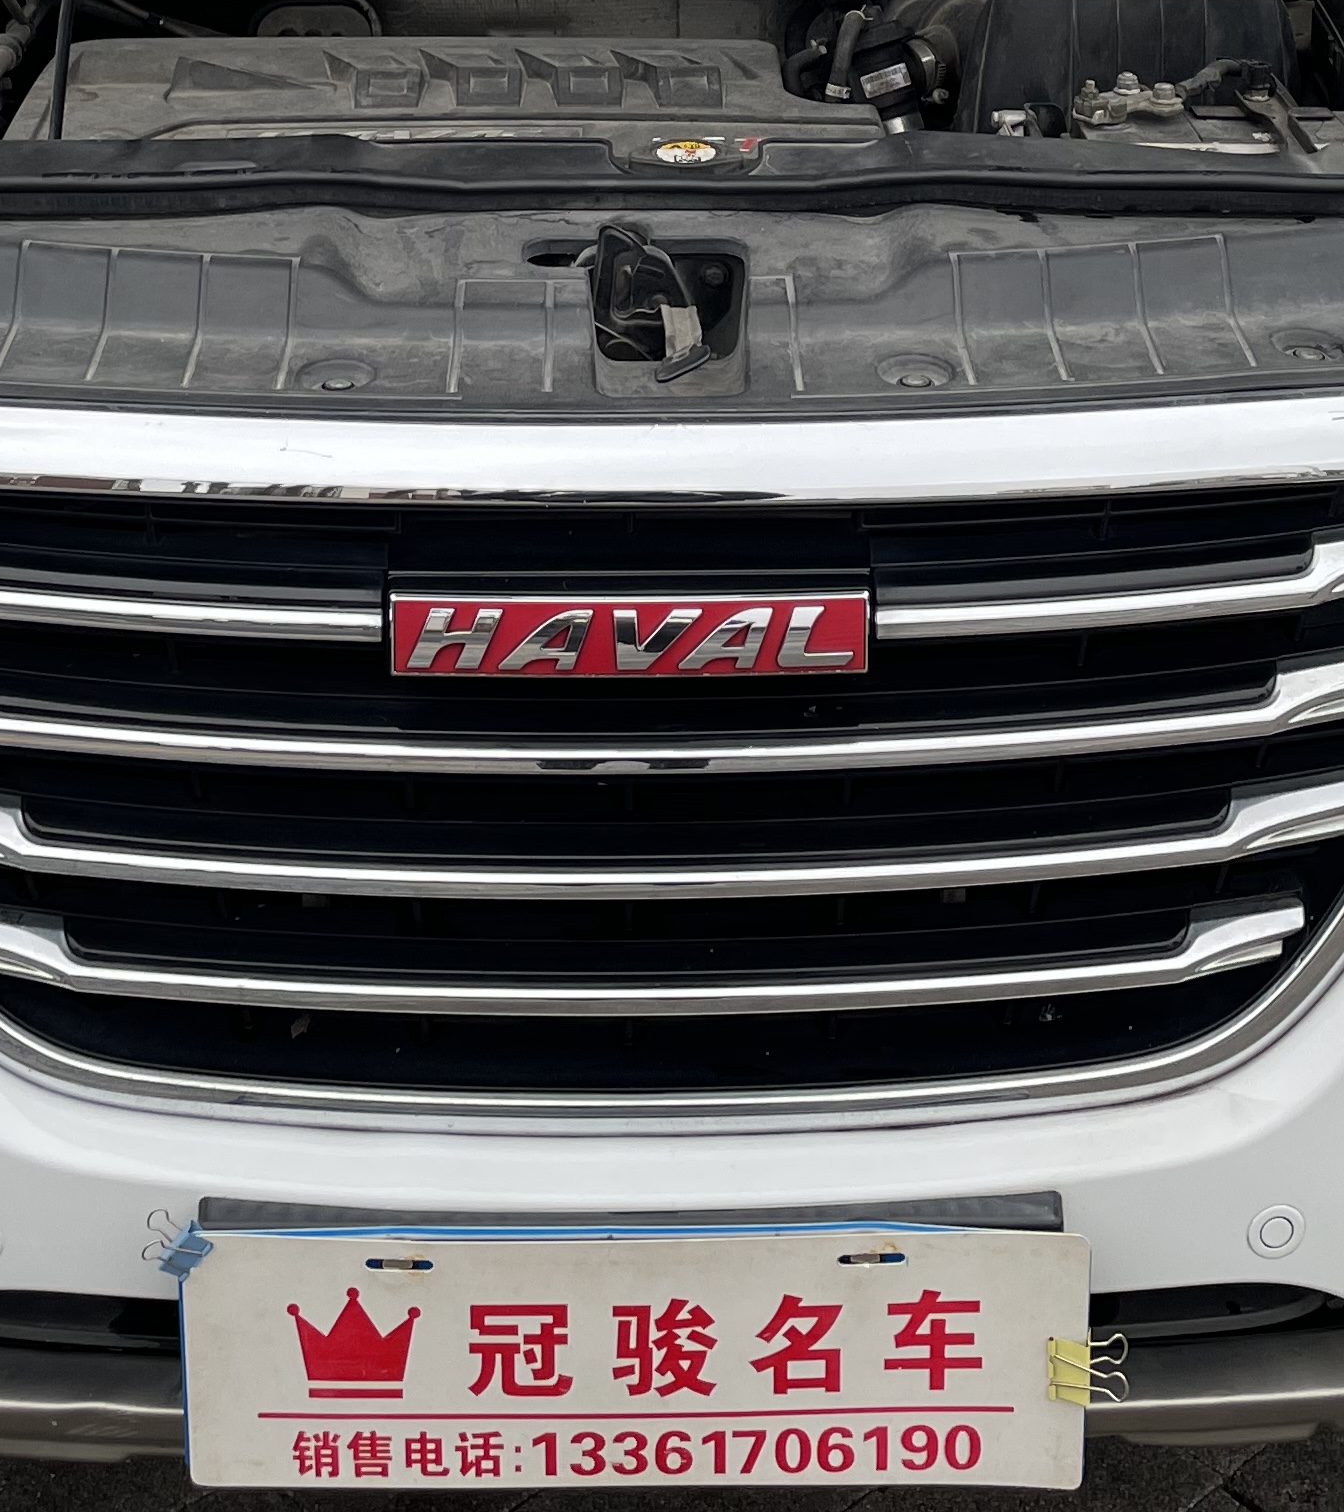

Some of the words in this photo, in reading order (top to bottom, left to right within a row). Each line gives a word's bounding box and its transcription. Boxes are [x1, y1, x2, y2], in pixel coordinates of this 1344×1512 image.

[406, 605, 855, 671] HAVAL
[466, 1286, 984, 1400] 冠骏名车
[291, 1423, 983, 1480] 销售电话:13361706190
